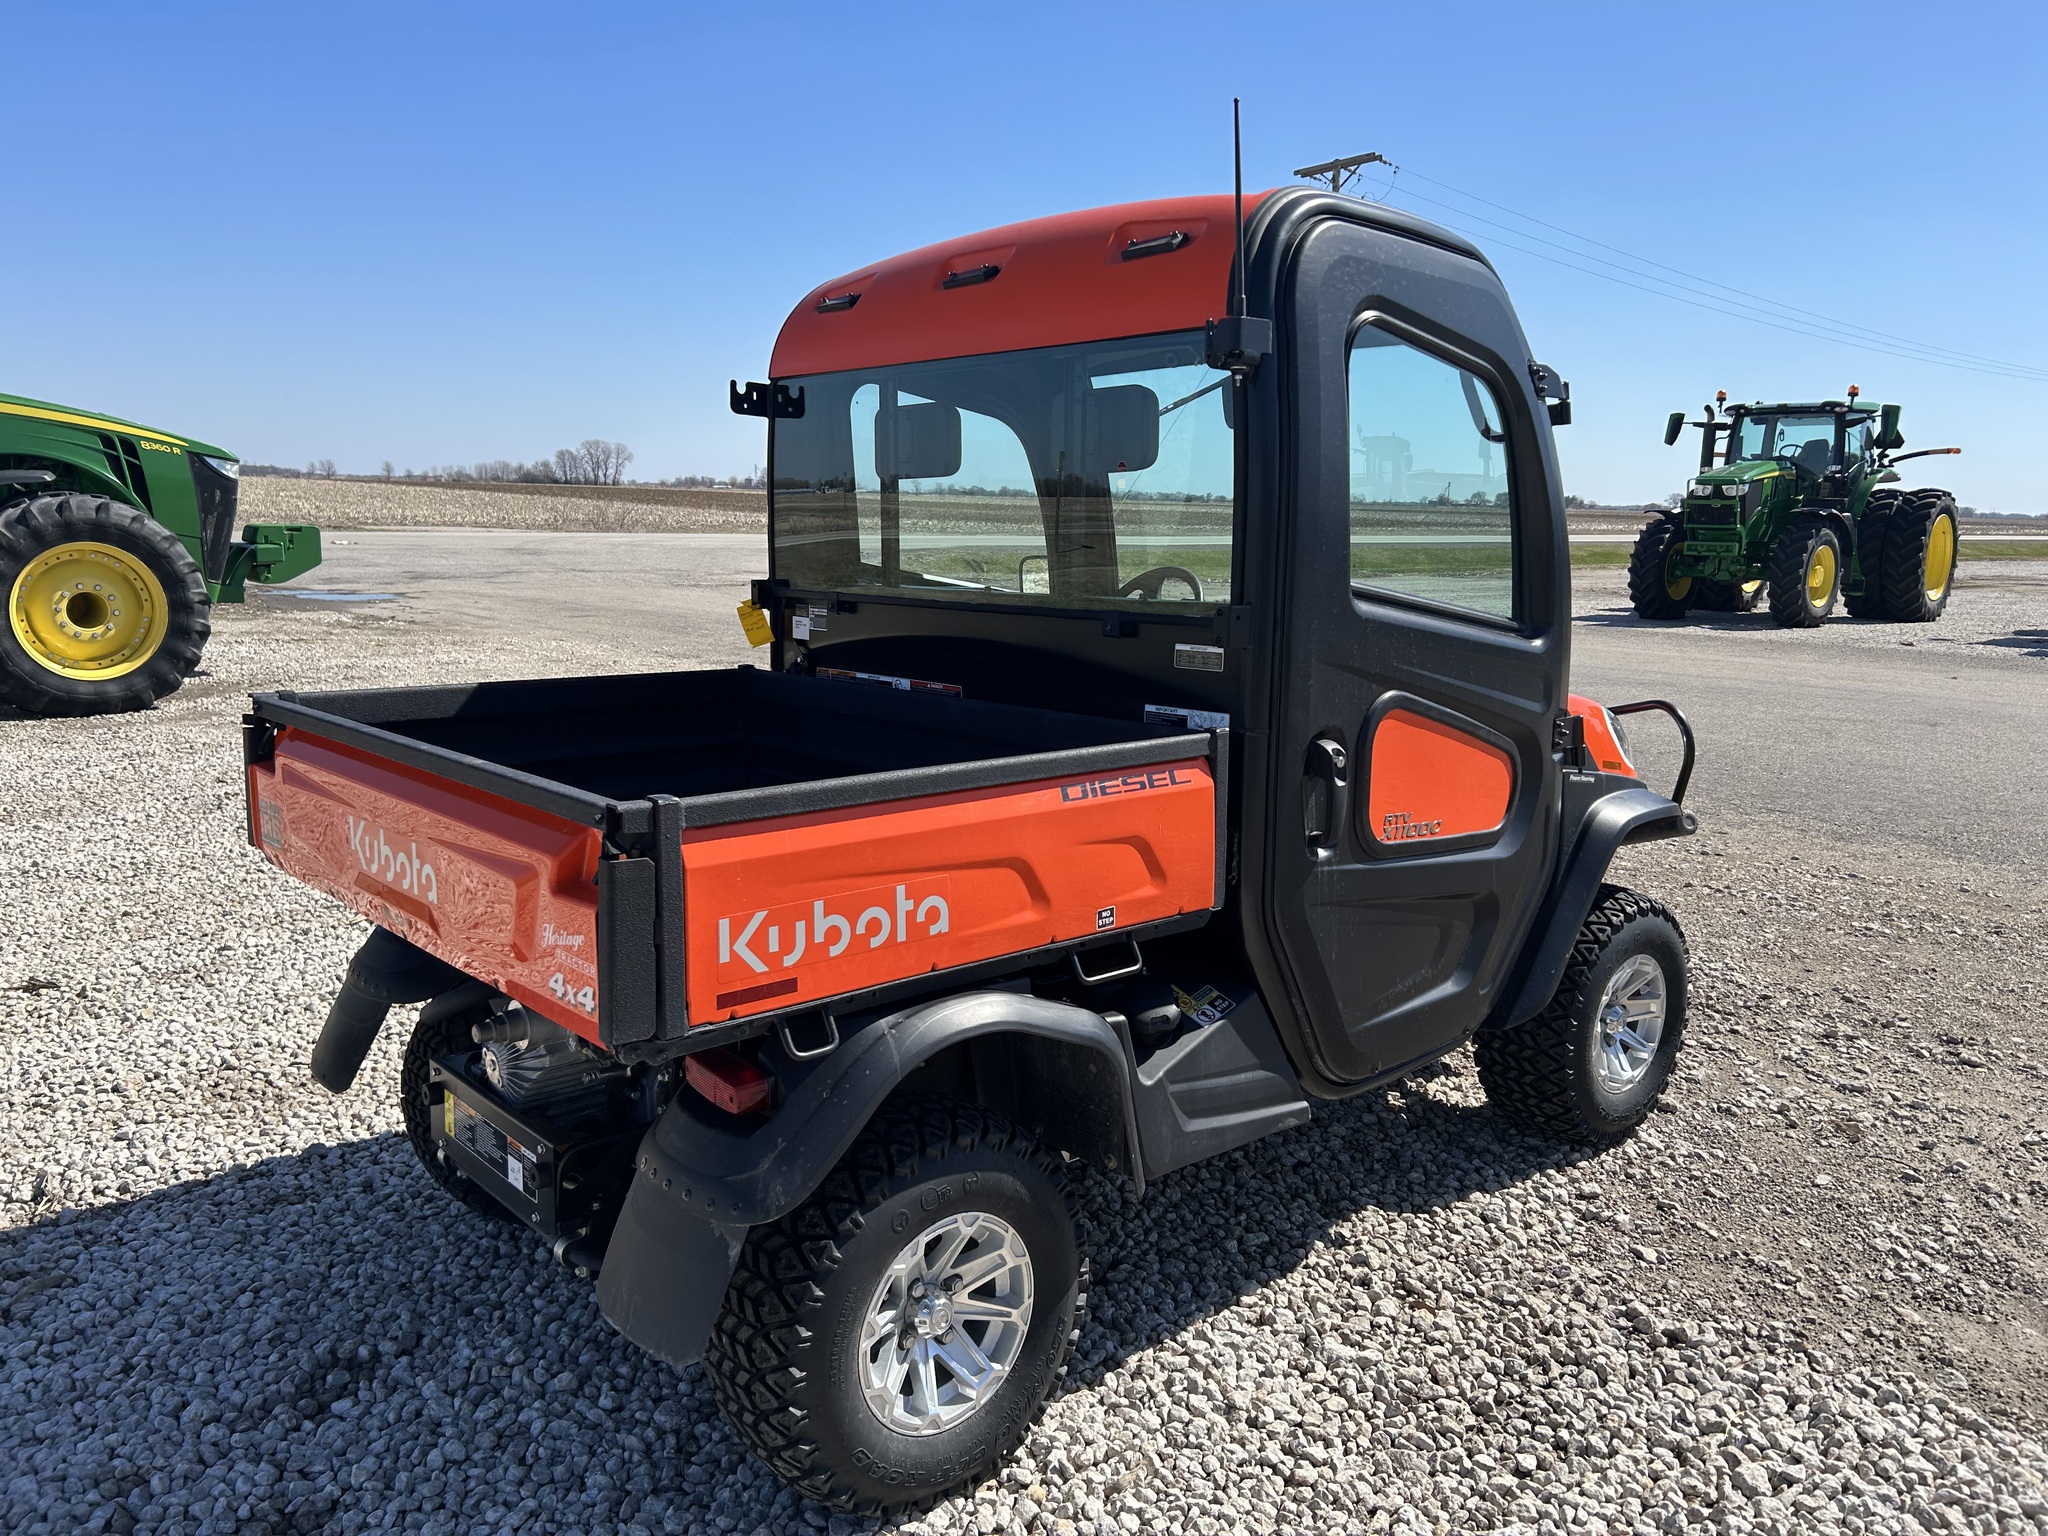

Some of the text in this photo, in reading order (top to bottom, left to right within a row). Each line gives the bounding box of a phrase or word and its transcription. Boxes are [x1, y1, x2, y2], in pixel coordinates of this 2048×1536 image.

[140, 440, 182, 456] 8360 R
[1155, 706, 1178, 714] IMPORTANT
[1060, 769, 1192, 803] DIESEL
[1383, 812, 1413, 826] RTV
[349, 815, 438, 905] Kubota
[1098, 916, 1114, 926] STEP
[1101, 910, 1111, 918] NO
[718, 884, 950, 973] Kubota
[541, 923, 585, 952] Heritage
[556, 950, 596, 977] TRACTOR
[548, 972, 595, 1013] 4x4
[1213, 998, 1223, 1007] NO
[1216, 1001, 1230, 1012] STEP
